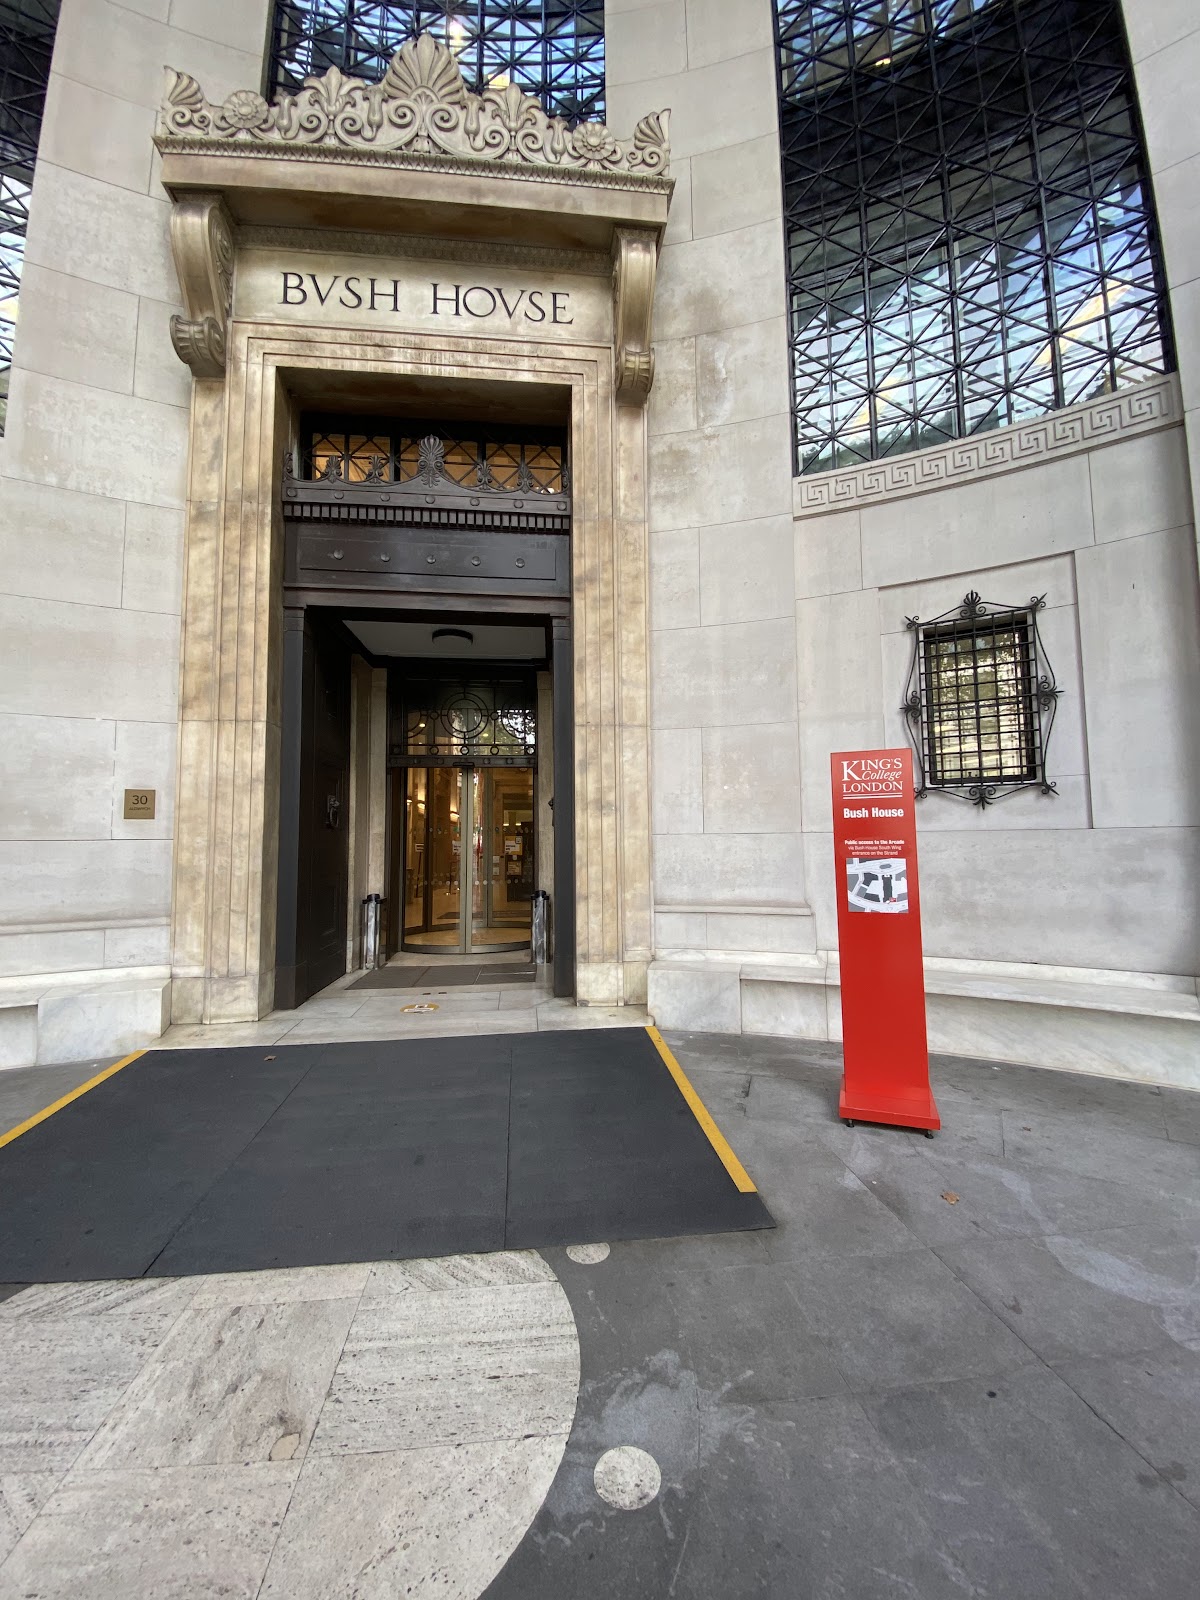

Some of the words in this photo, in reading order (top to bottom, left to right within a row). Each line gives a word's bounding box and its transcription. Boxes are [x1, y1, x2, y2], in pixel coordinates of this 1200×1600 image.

[277, 271, 401, 312] BVSH
[429, 282, 575, 325] HOVSE
[841, 757, 903, 781] KING'S
[861, 769, 902, 782] College
[842, 780, 904, 793] LONDON
[132, 794, 148, 805] 30
[843, 807, 869, 819] Bush
[871, 807, 904, 818] House
